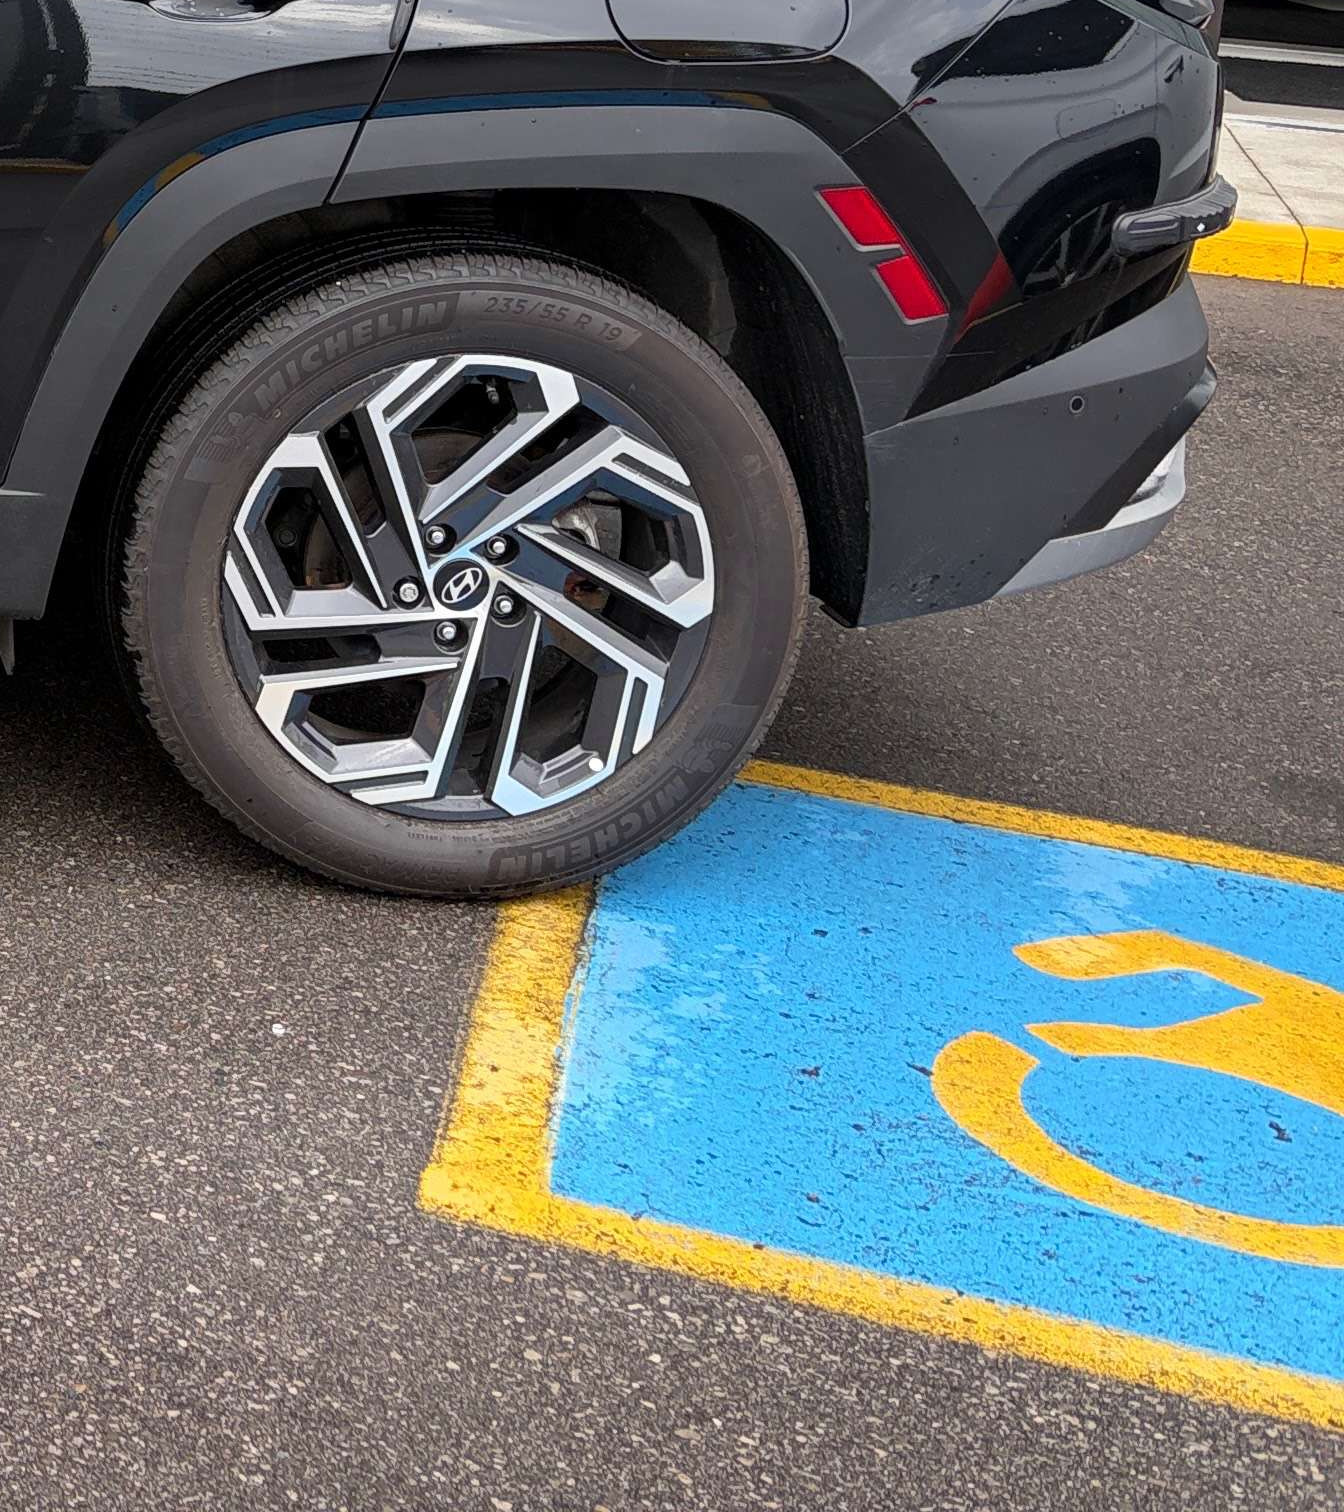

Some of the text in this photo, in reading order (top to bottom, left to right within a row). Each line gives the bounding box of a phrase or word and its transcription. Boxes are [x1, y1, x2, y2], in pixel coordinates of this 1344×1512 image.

[254, 296, 624, 407] MICHELIN 235/55 R 19
[499, 775, 689, 879] MICHELIN
